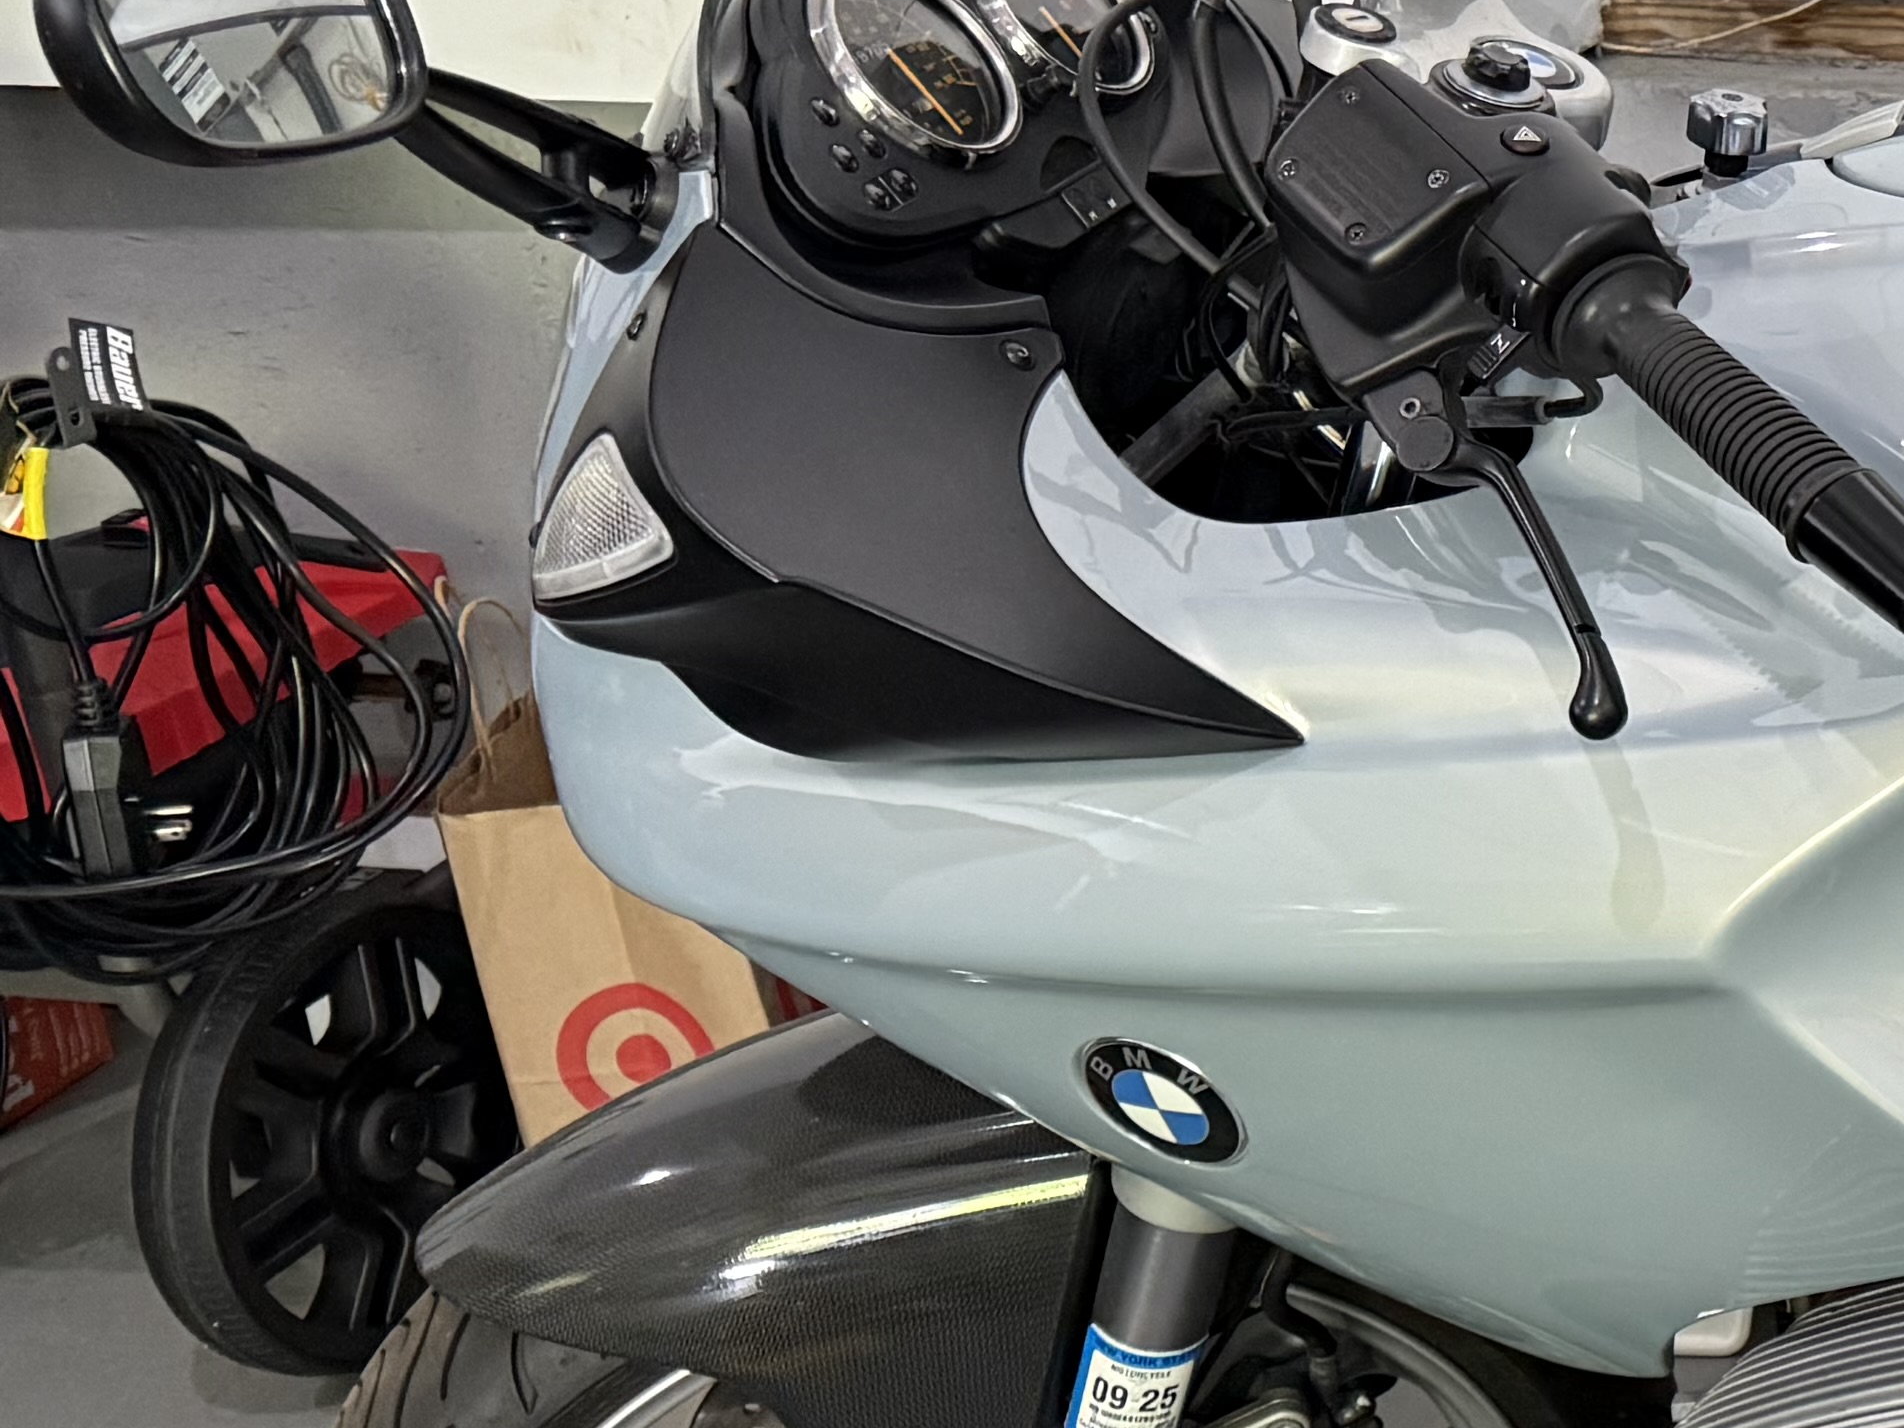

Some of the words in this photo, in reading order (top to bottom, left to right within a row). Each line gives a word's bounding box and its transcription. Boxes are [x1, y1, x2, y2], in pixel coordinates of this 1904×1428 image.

[106, 326, 144, 411] Bauer
[1090, 1047, 1209, 1096] BMW
[1093, 1376, 1128, 1410] 09
[1139, 1383, 1179, 1412] 25
